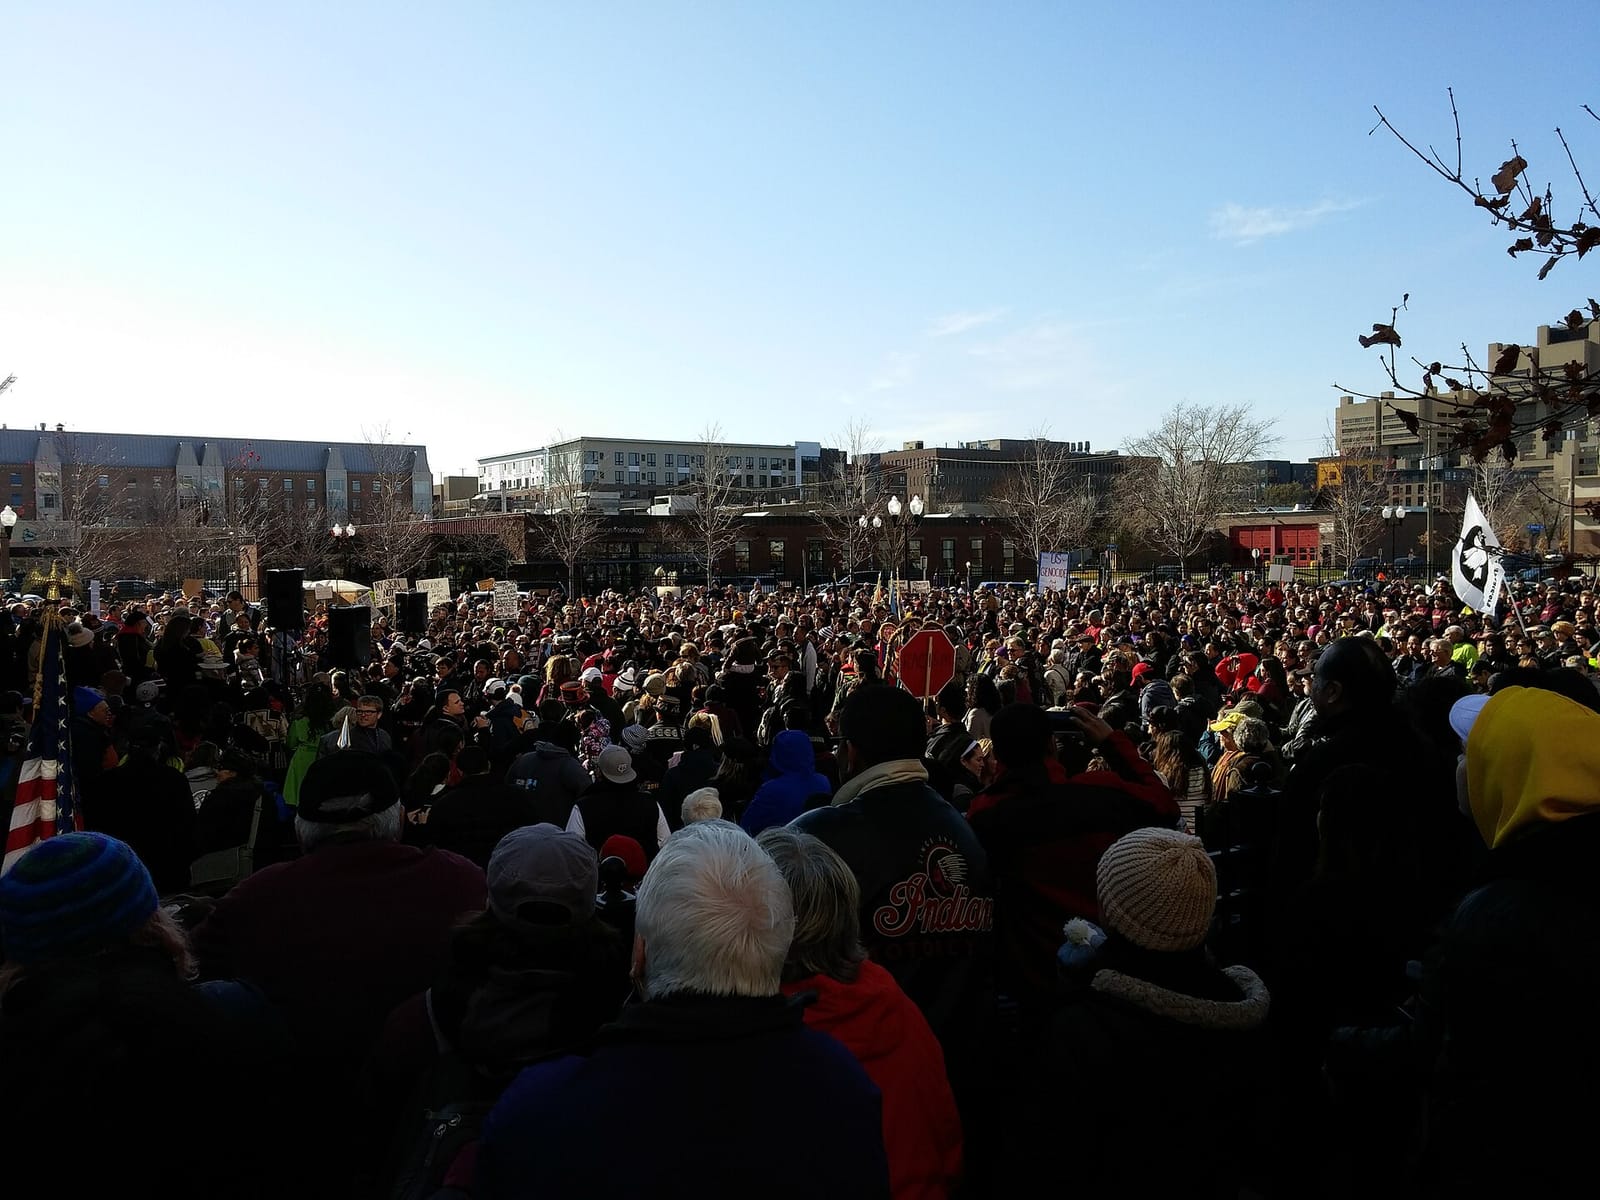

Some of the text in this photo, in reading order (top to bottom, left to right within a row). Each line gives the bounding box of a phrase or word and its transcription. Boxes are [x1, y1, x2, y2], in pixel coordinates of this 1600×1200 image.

[1050, 553, 1062, 564] US
[1040, 567, 1067, 578] GENOCIDE
[873, 872, 994, 937] Indian
